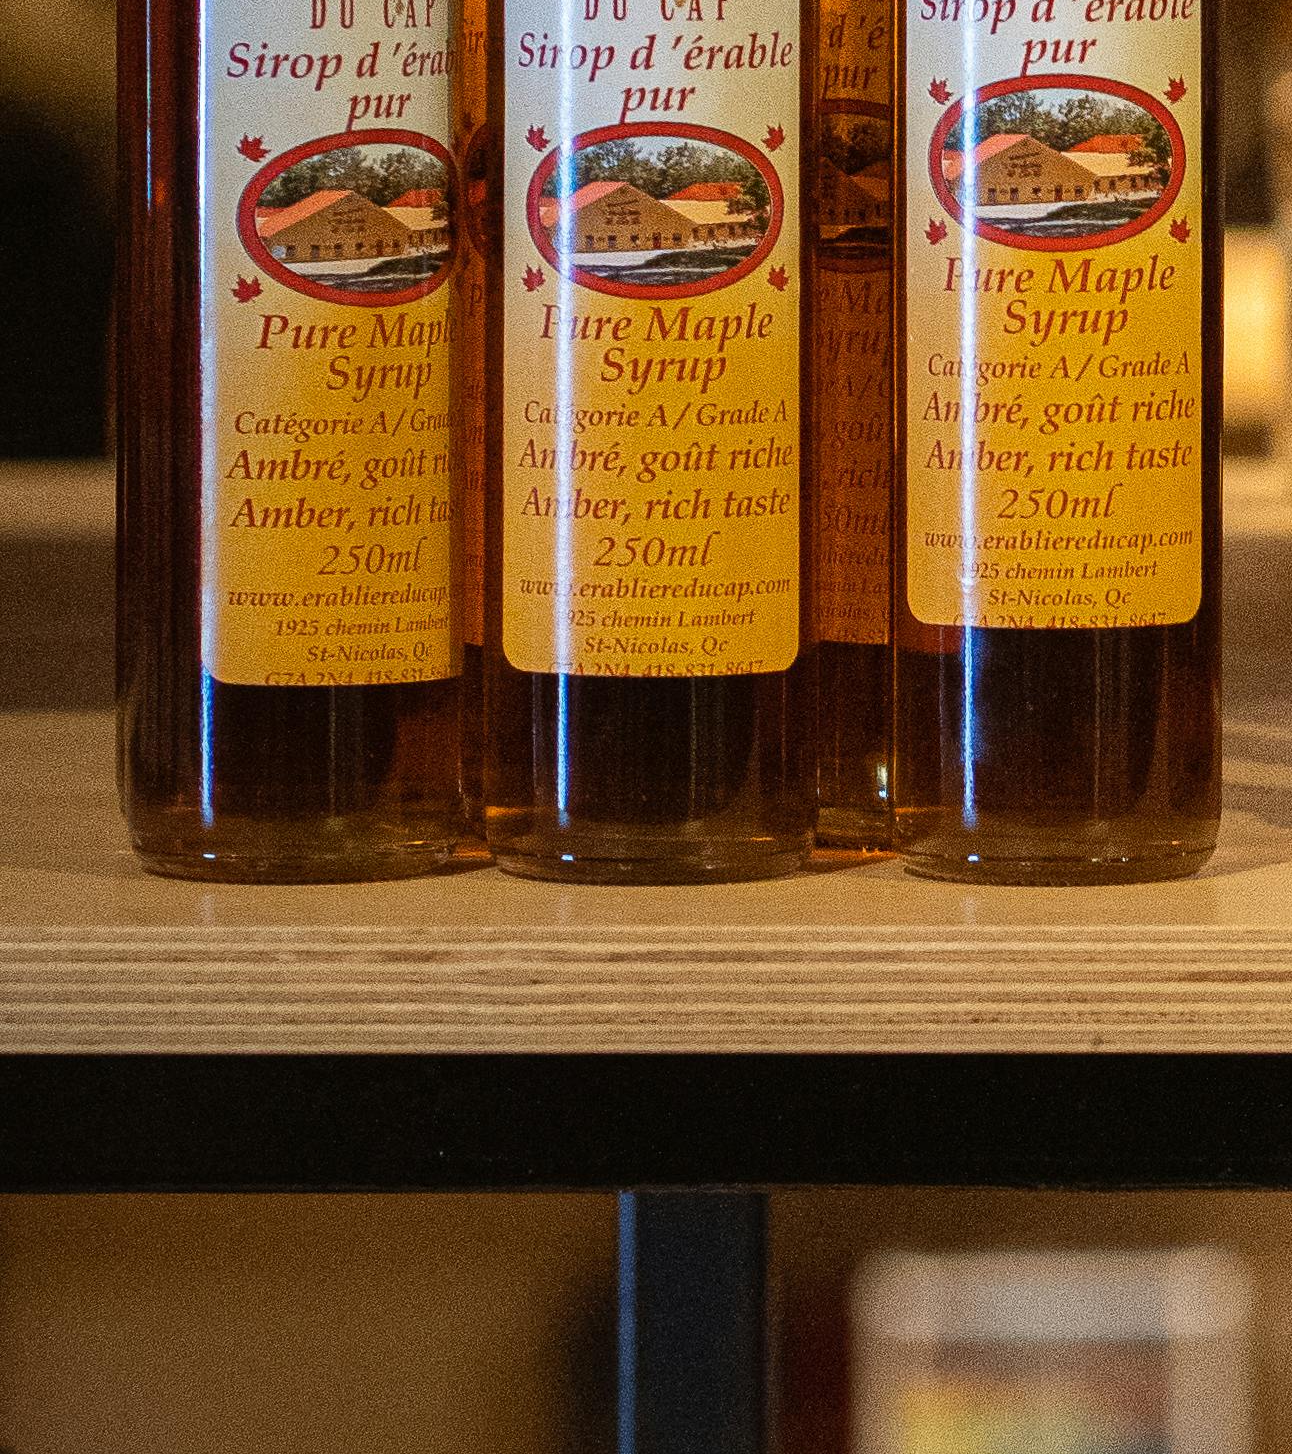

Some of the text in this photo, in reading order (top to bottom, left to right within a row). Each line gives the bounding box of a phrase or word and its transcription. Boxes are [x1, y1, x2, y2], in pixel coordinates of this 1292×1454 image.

[226, 41, 342, 91] Sirop
[518, 32, 615, 82] Sirop
[1020, 35, 1098, 75] pur
[346, 94, 412, 132] pur
[619, 83, 696, 124] pur
[1048, 255, 1176, 303] Maple
[257, 313, 356, 350] Pure
[647, 302, 774, 353] Maple
[1003, 299, 1129, 347] Syrup
[325, 354, 432, 403] Syrup
[600, 346, 727, 394] Syrup
[1098, 355, 1171, 379] Grade
[235, 409, 362, 444] Catégorie
[697, 403, 769, 427] Grade
[1038, 390, 1195, 435] goût riche
[226, 448, 428, 490] Ambré, goût
[637, 436, 794, 483] goût riche
[1048, 440, 1193, 472] rich taste
[229, 494, 422, 533] Amber, rich
[645, 488, 791, 522] rich taste
[998, 483, 1124, 519] 250ml
[317, 535, 427, 576] 250ml
[594, 531, 720, 568] 250ml
[1004, 560, 1158, 580] chemin Lambert
[988, 587, 1132, 607] St-Nicolas, Qc
